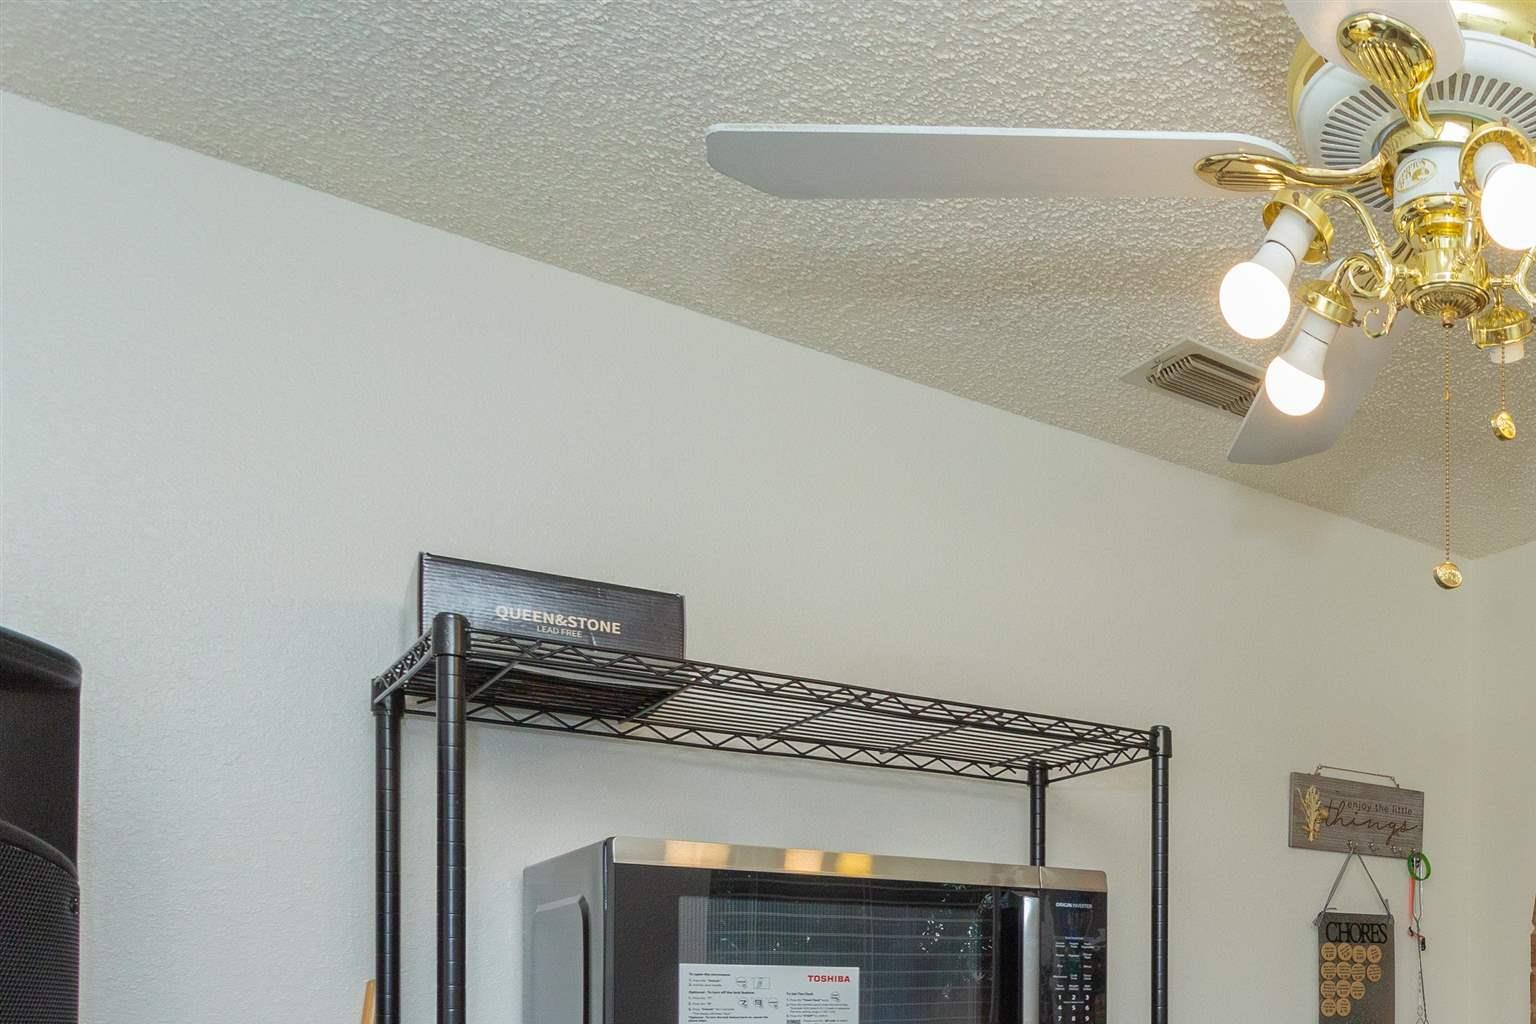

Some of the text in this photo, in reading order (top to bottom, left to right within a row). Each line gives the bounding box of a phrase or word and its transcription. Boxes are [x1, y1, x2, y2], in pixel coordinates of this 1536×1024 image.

[495, 605, 622, 635] QUEEN&STONE
[536, 624, 583, 639] LEAD FREE
[1347, 801, 1413, 816] enjoy the little
[1325, 798, 1418, 845] things
[1325, 921, 1388, 944] CHORES
[807, 974, 851, 983] TOSHIBA
